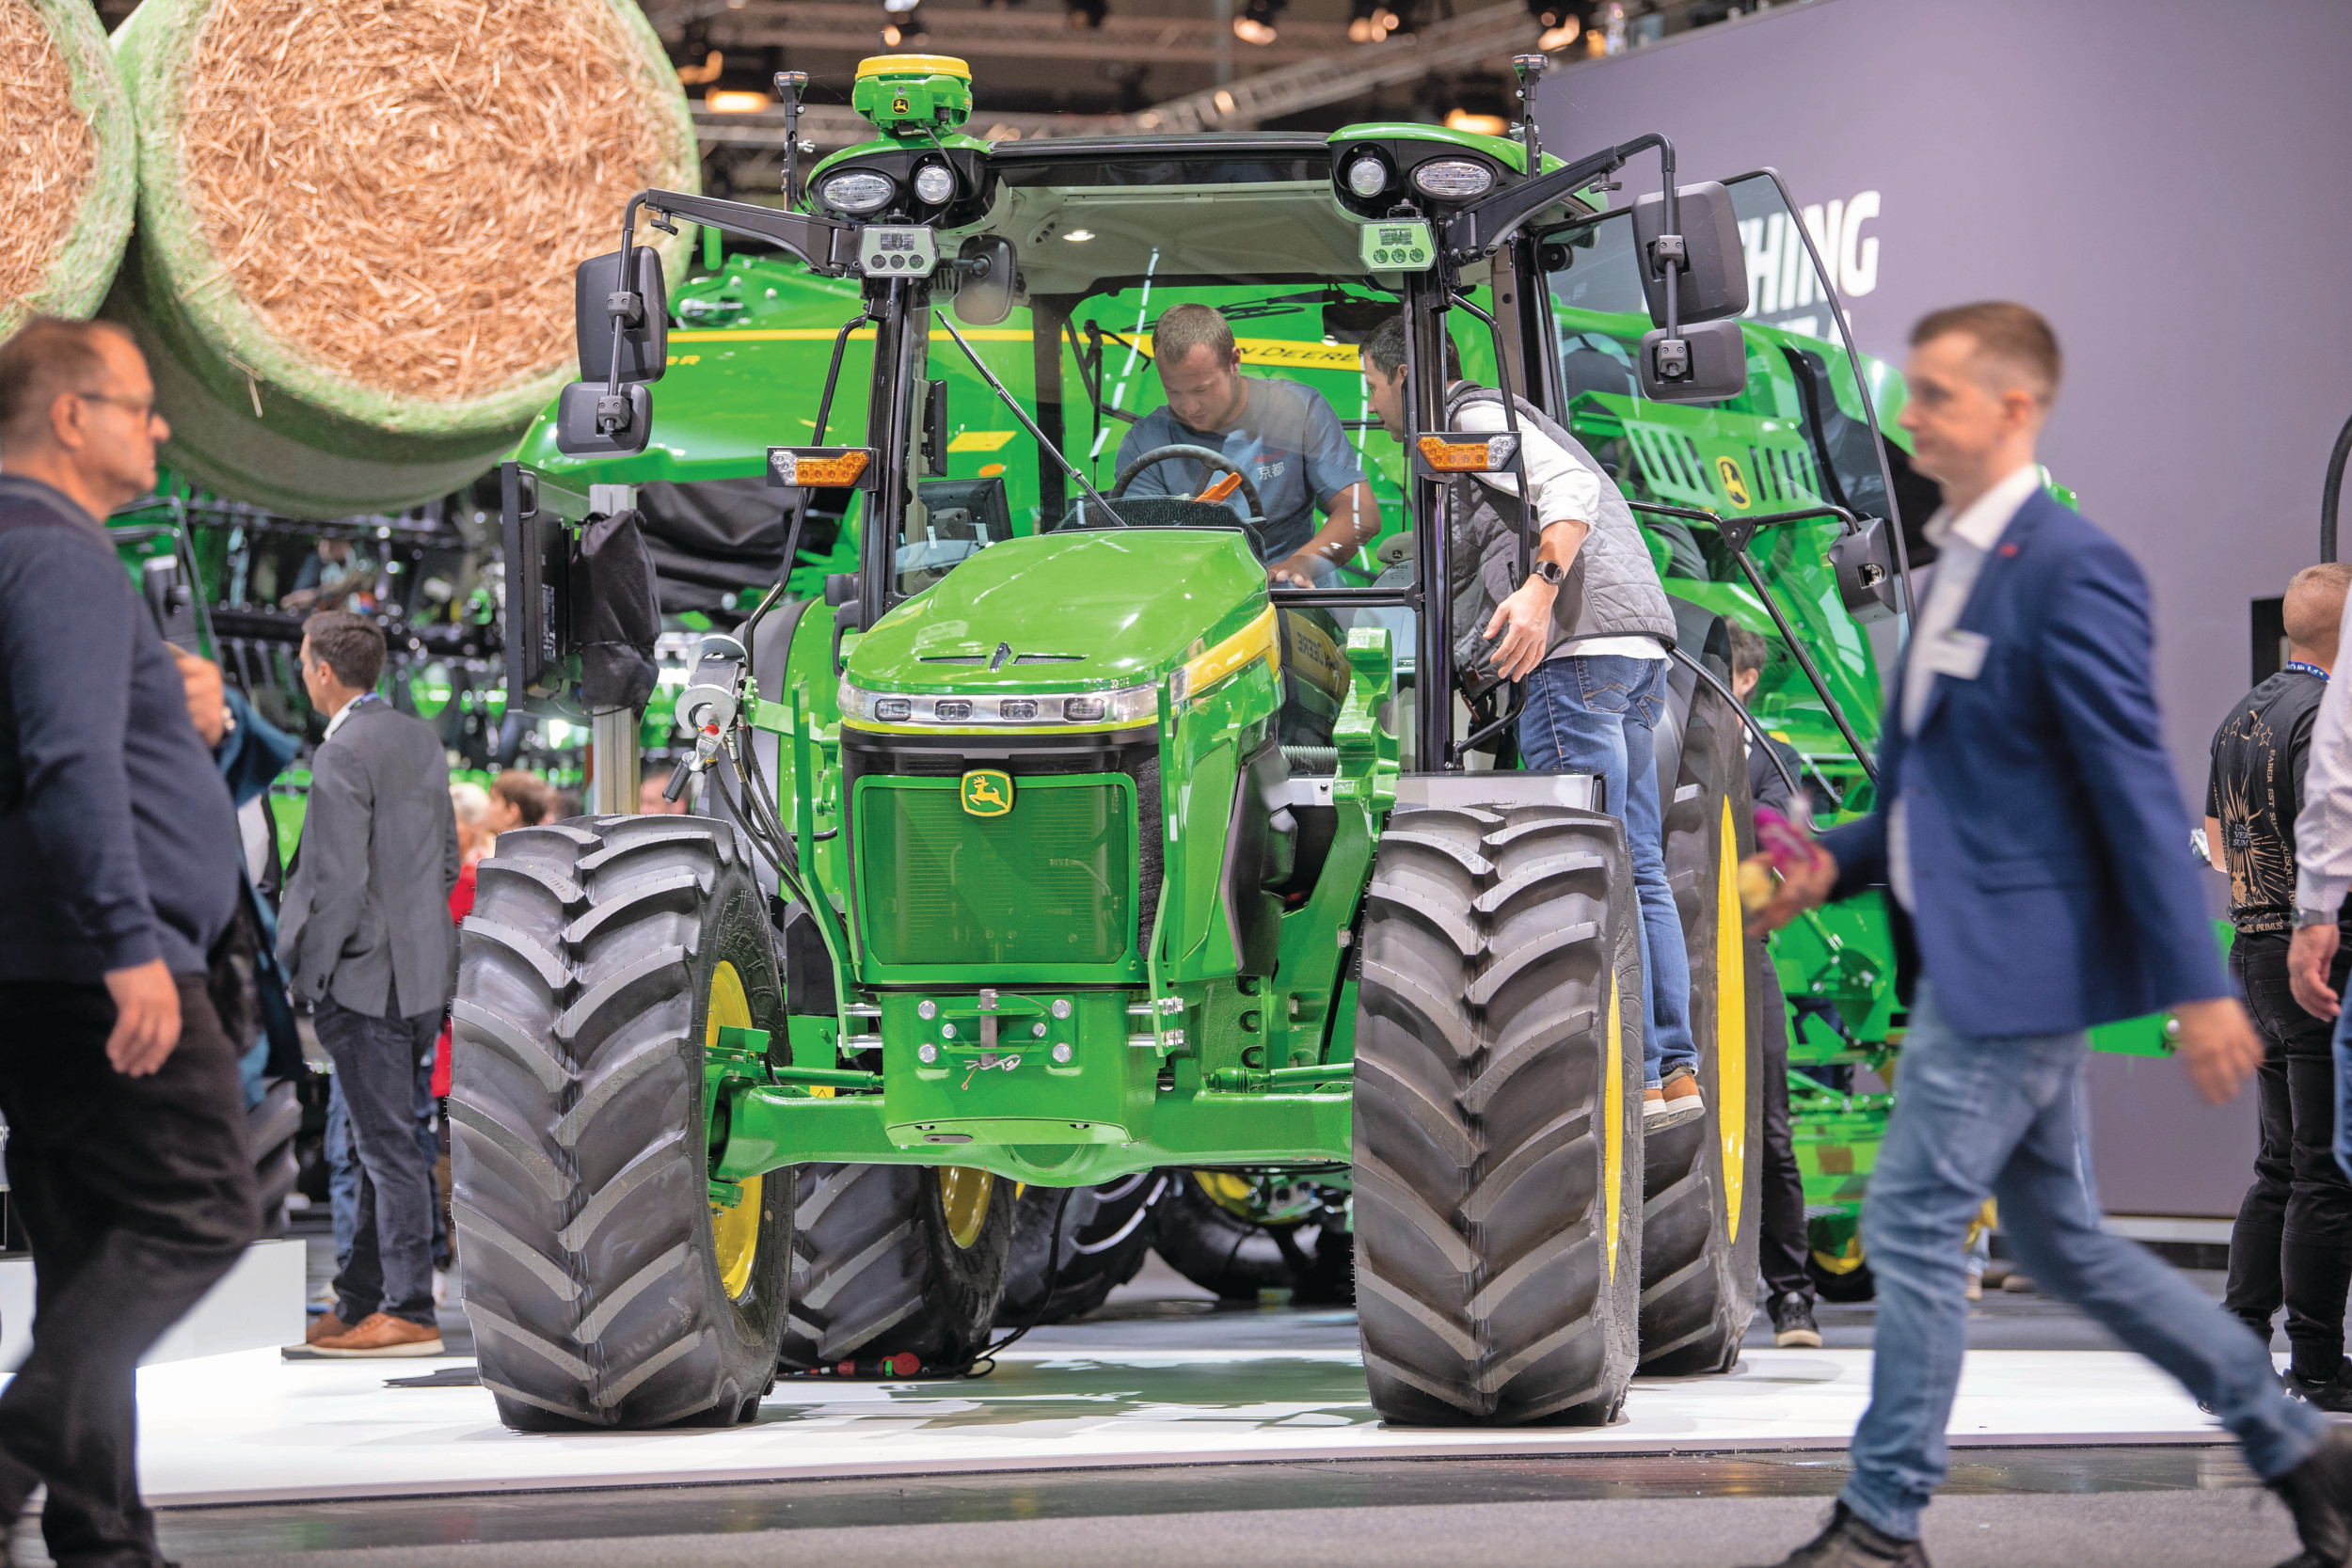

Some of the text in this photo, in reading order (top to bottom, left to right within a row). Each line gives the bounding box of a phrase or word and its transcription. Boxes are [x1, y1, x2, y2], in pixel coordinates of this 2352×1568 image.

[1738, 190, 1881, 319] HING
[1259, 346, 1359, 362] DEERE
[1257, 461, 1285, 481] 京都
[2266, 749, 2276, 784] FABER
[2280, 841, 2295, 886] QUISQUE
[2255, 921, 2284, 932] PRIMUS
